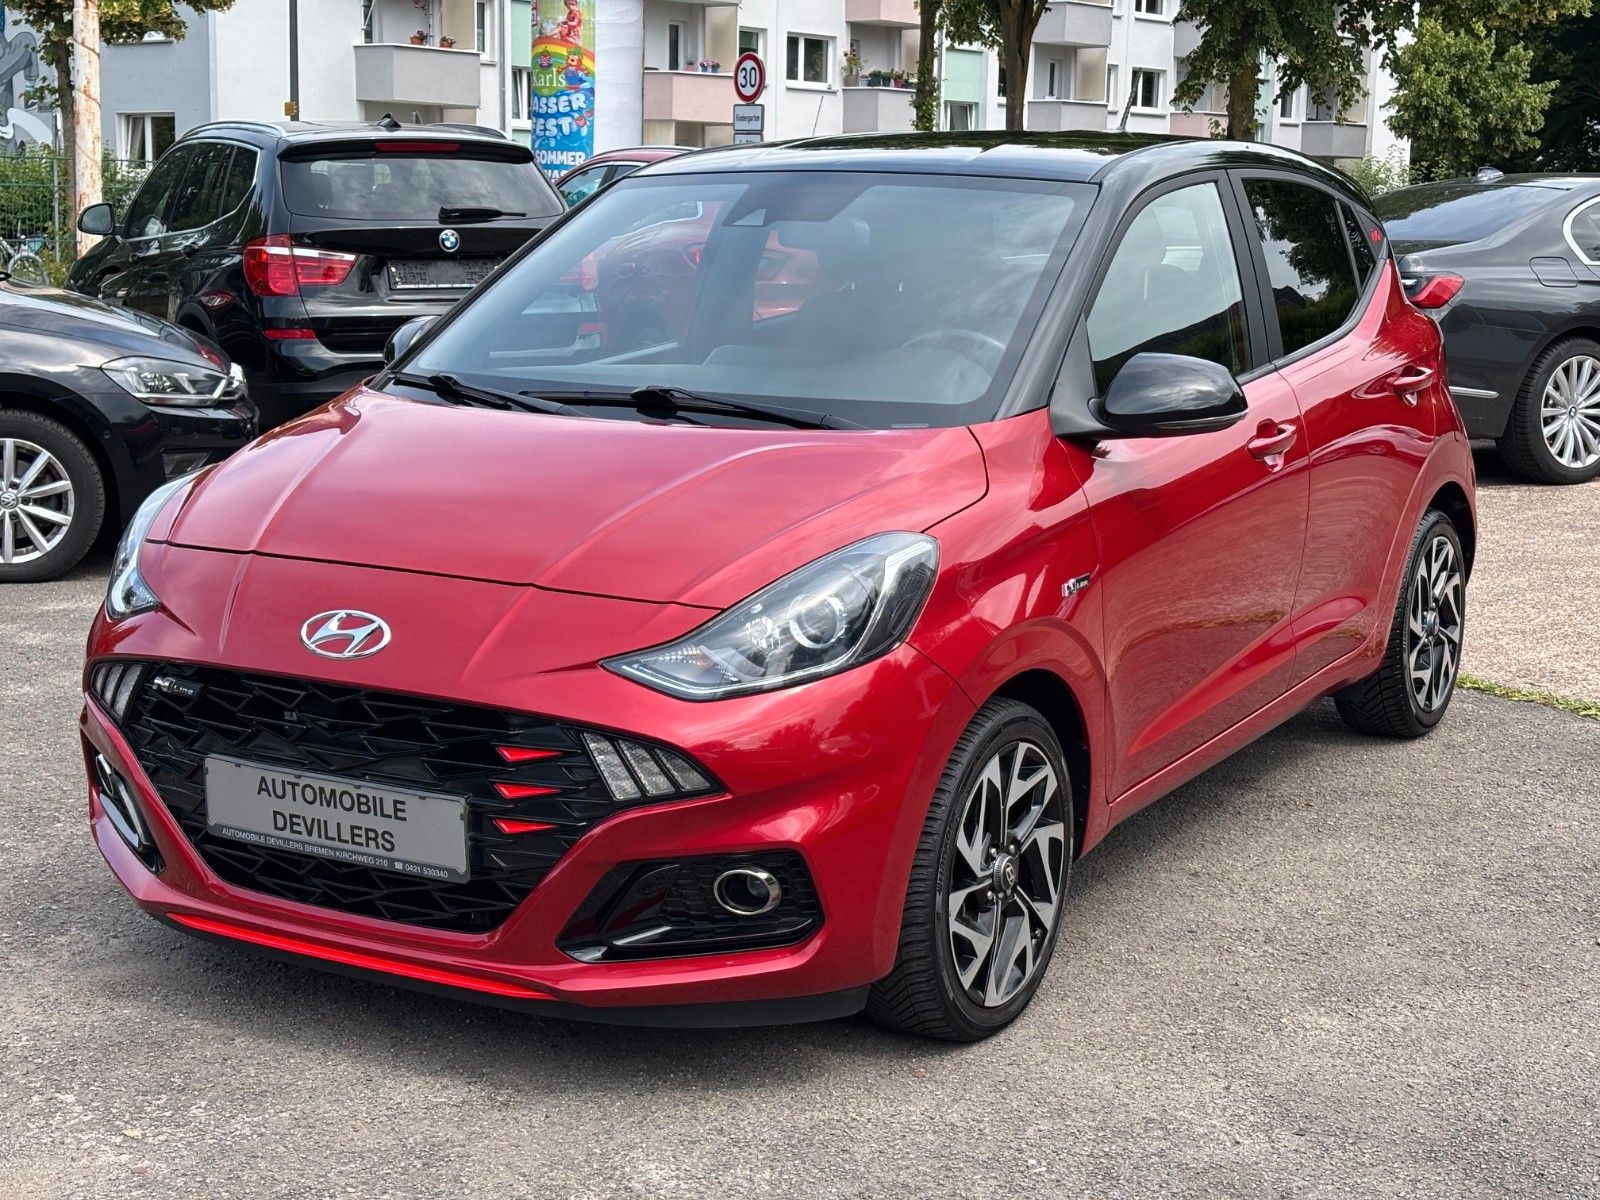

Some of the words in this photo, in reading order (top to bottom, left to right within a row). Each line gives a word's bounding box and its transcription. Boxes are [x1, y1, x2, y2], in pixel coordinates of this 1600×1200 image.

[532, 68, 566, 86] Karls
[740, 67, 757, 88] 30
[532, 93, 587, 114] ASSER
[535, 150, 585, 166] SOMMER
[257, 775, 407, 821] AUTOMOBILE
[272, 810, 395, 852] DEVILLERS
[222, 828, 266, 843] AUTOMOBILE
[266, 836, 303, 851] DEVILLERS
[304, 845, 334, 857] BREMEN
[336, 850, 374, 864] KIRCHWEG
[375, 858, 389, 867] 210
[405, 864, 421, 873] 0421
[423, 867, 449, 879] 530340
